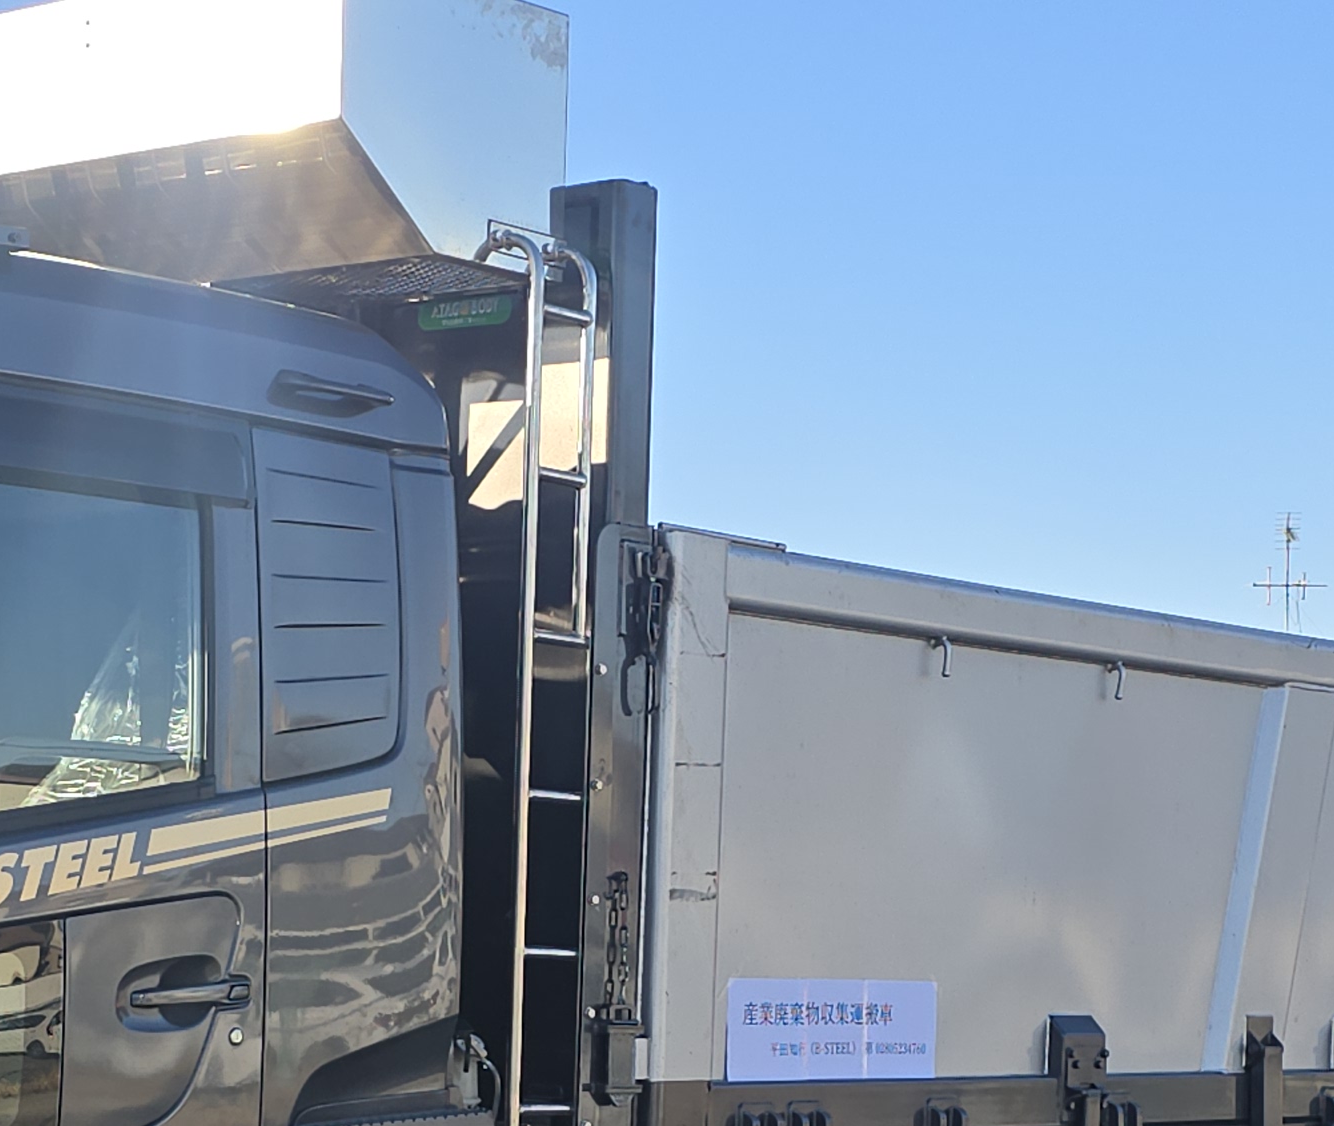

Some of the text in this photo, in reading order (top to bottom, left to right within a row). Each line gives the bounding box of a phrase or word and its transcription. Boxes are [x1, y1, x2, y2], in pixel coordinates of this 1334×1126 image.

[742, 1001, 894, 1027] 産業廃棄物収集運搬車
